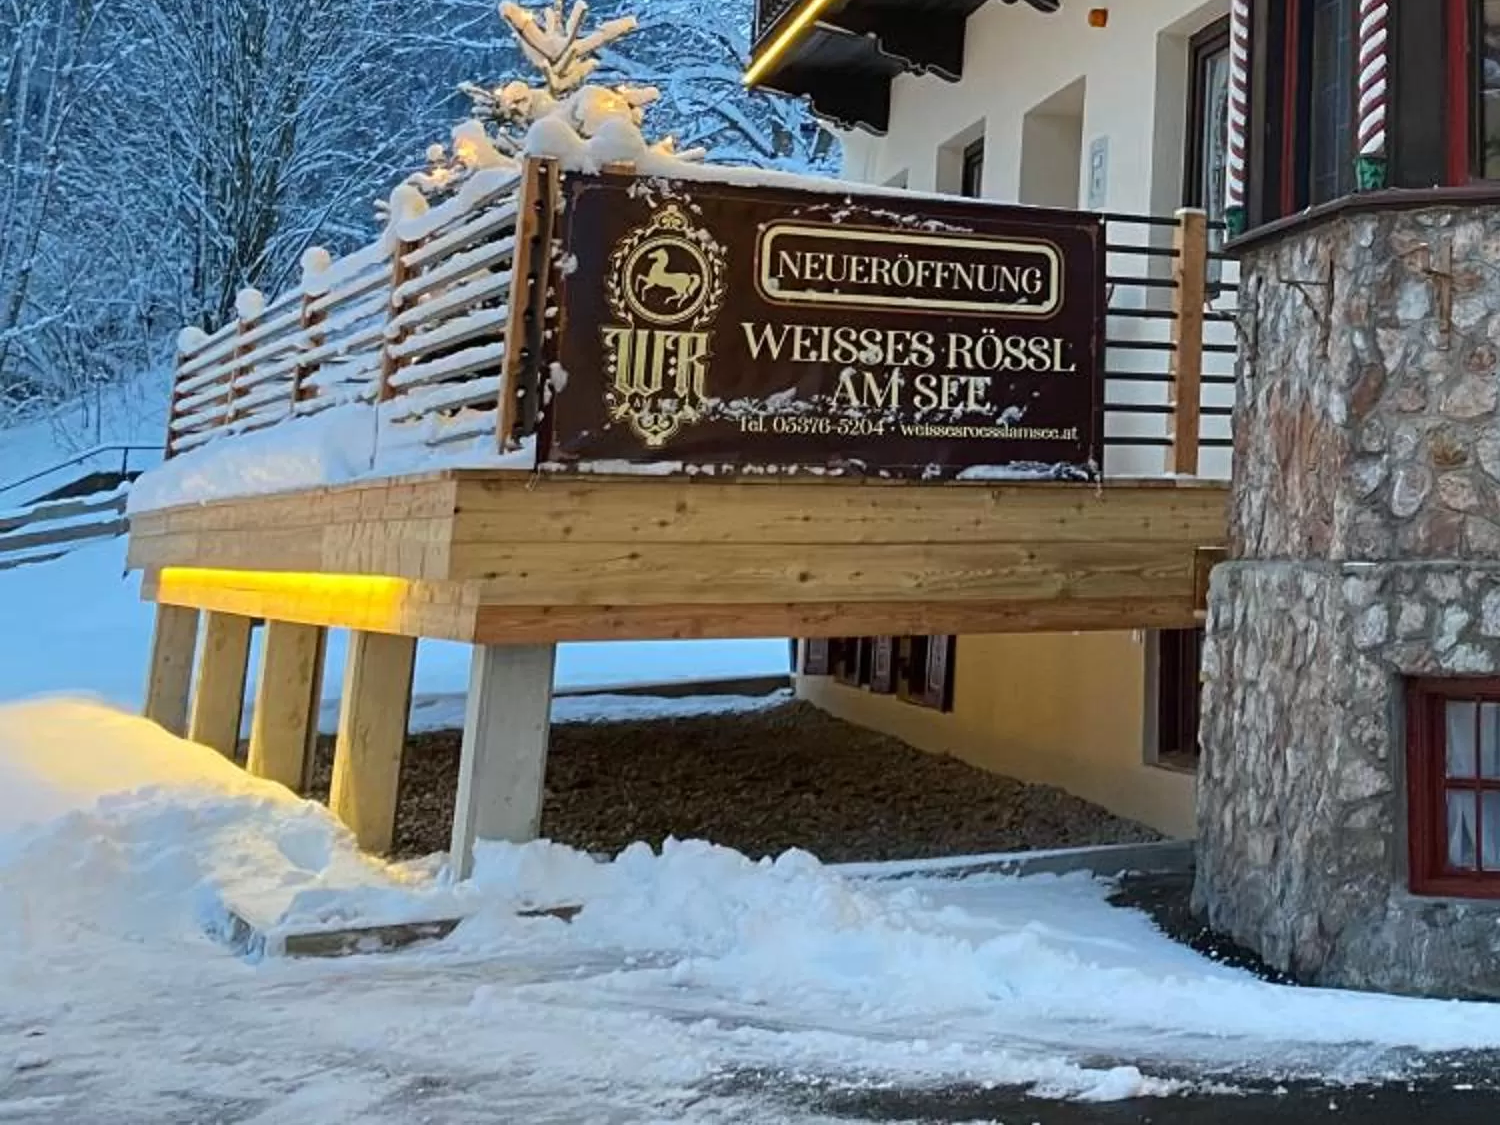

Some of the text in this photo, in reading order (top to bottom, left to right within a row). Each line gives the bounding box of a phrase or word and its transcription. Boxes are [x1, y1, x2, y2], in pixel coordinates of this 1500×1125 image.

[776, 249, 1043, 295] NEUERÖFFNUNG
[740, 322, 1077, 373] WEISSES RÖSSL
[832, 367, 993, 415] AM SEE
